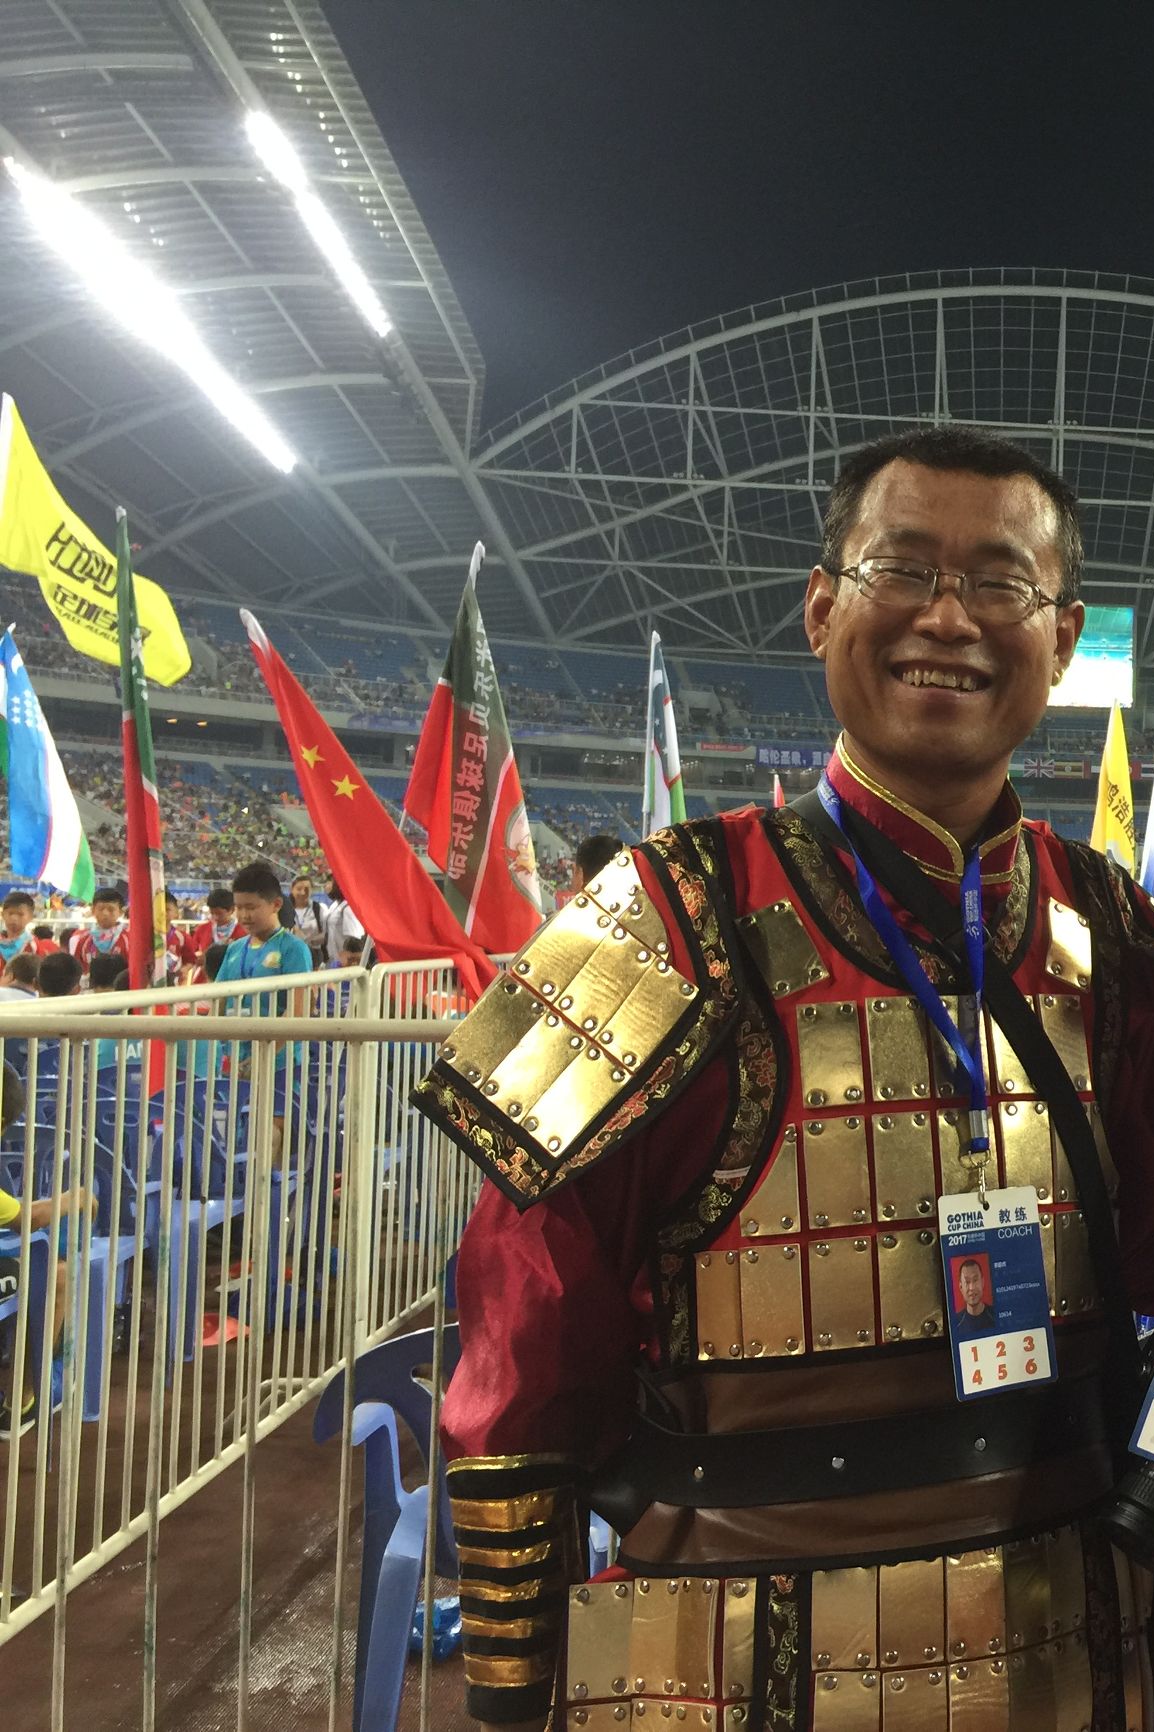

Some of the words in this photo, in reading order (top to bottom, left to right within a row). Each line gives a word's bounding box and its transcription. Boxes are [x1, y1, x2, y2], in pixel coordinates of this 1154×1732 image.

[947, 1211, 984, 1224] GOTHIA
[999, 1207, 1028, 1224] 教练
[948, 1223, 961, 1232] CUP
[962, 1221, 985, 1230] CHINA
[997, 1225, 1033, 1239] COACH
[948, 1235, 967, 1247] 2017
[971, 1346, 979, 1363] 1
[995, 1341, 1007, 1358] 2
[1023, 1335, 1035, 1353] 3
[972, 1369, 983, 1386] 4
[998, 1364, 1008, 1381] 5
[1025, 1358, 1038, 1375] 6
